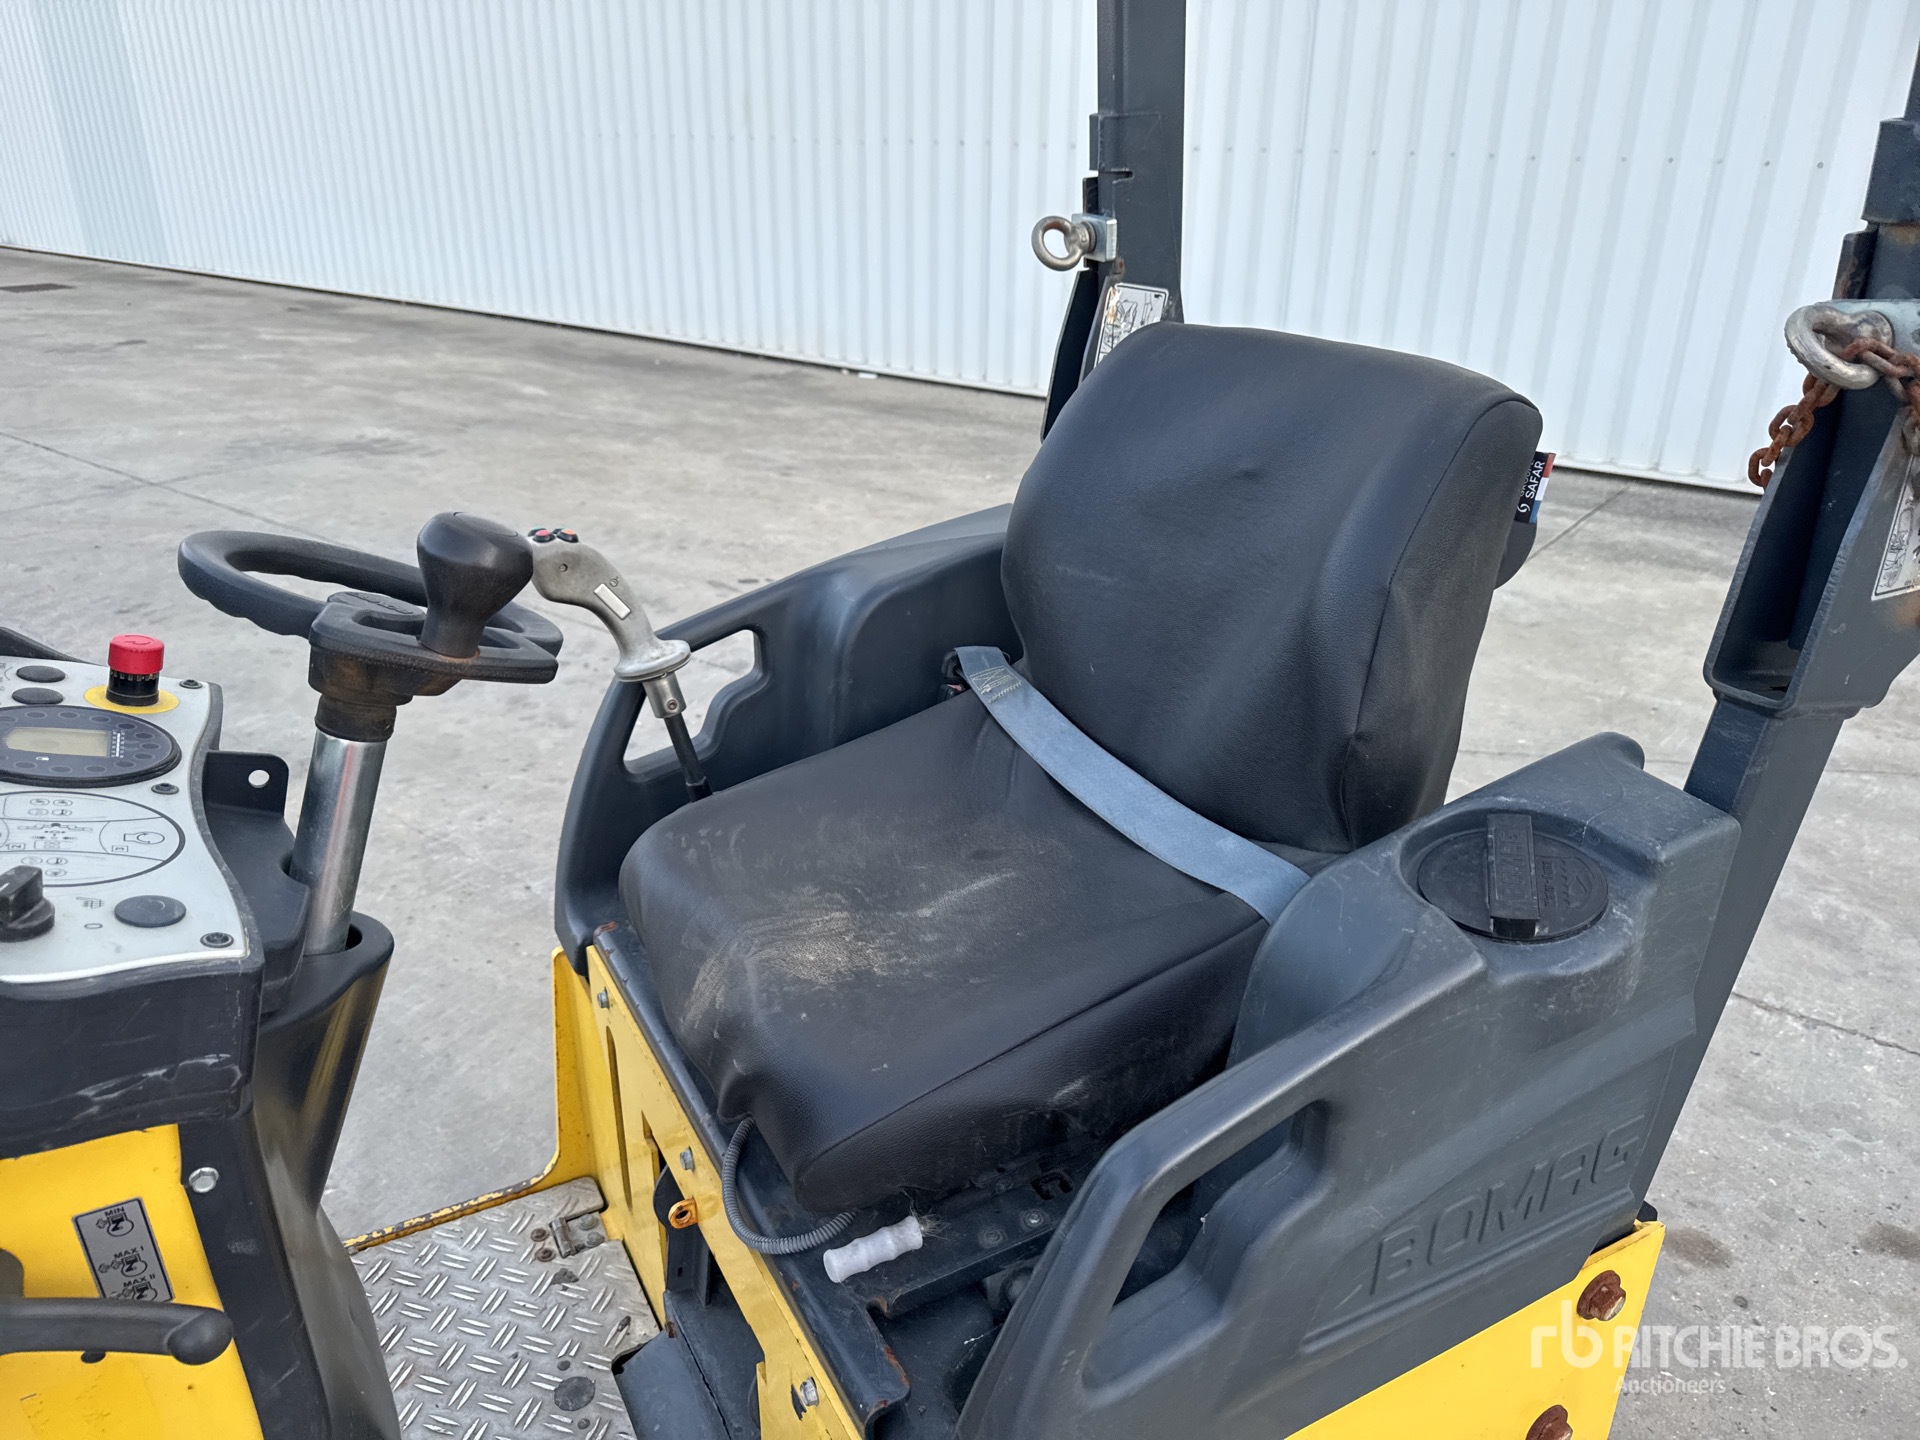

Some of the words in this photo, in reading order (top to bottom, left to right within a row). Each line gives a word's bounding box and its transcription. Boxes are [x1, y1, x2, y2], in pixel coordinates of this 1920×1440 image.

[1525, 461, 1545, 499] SAFAR
[1368, 1112, 1646, 1298] BOMAG
[104, 1206, 125, 1217] MIN
[114, 1247, 138, 1258] MAX
[123, 1276, 146, 1287] MAX
